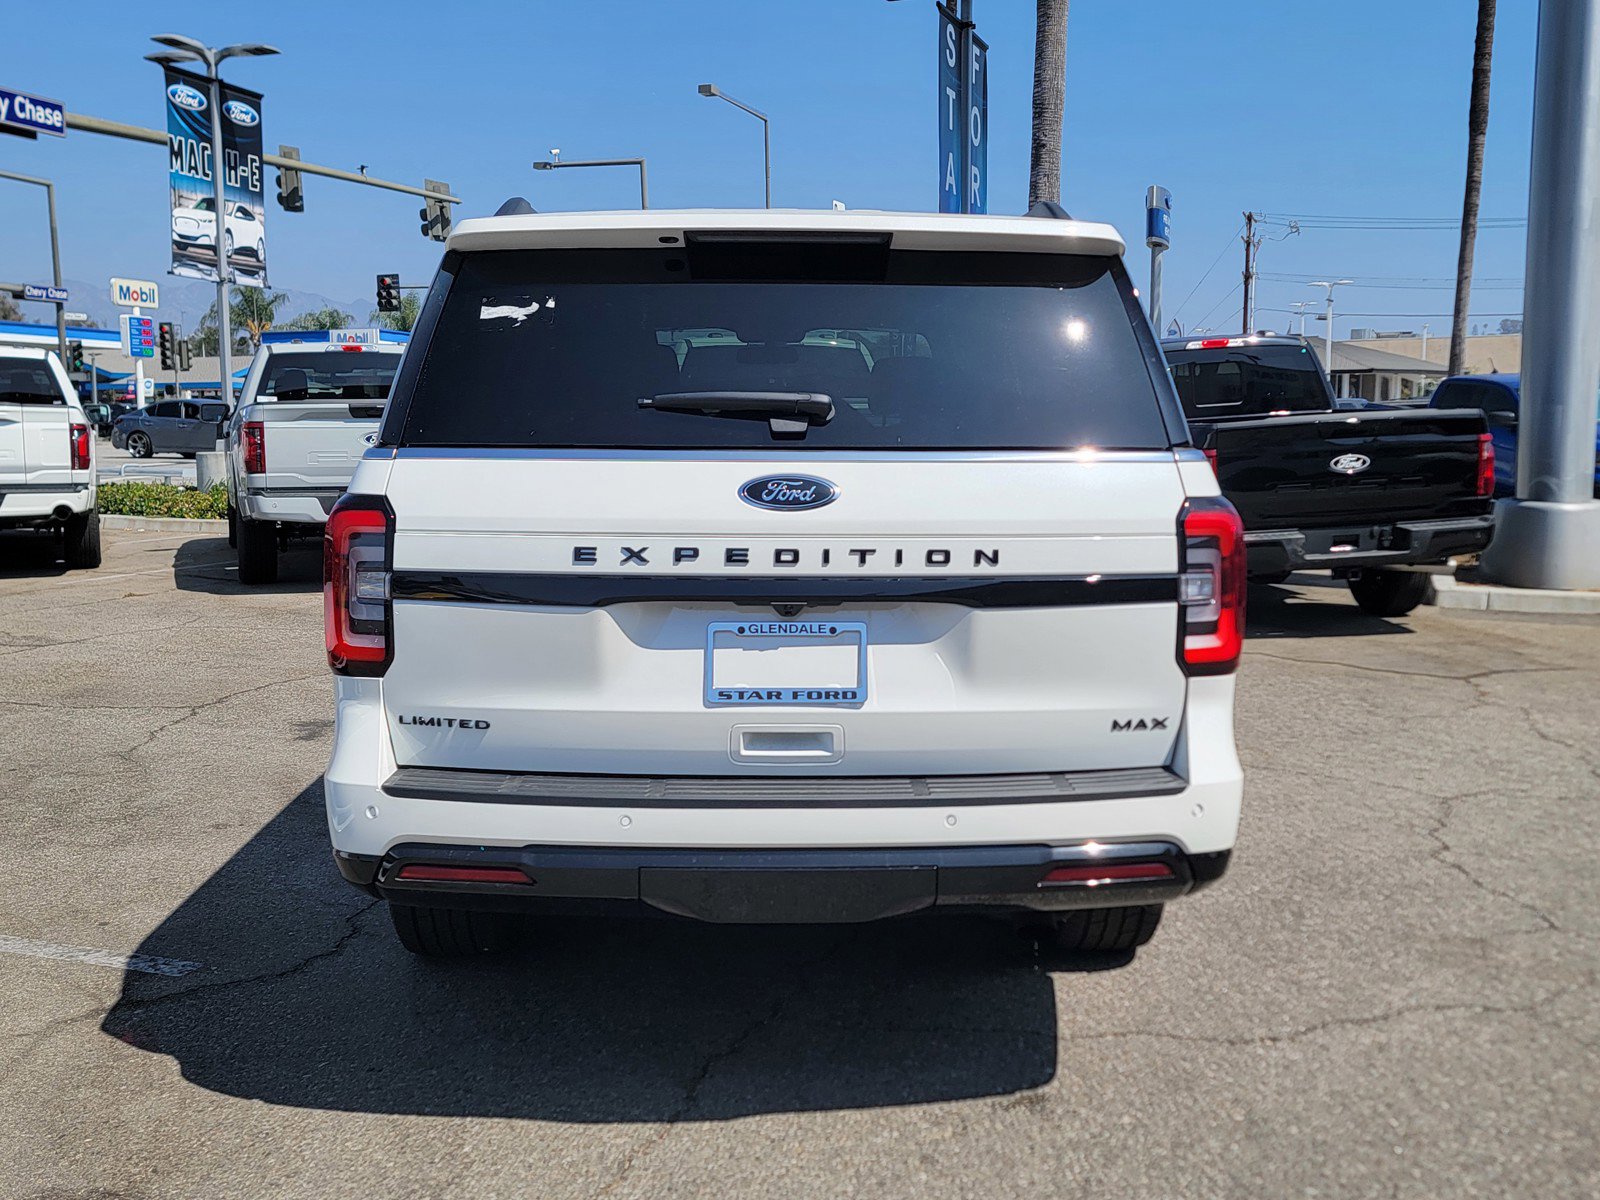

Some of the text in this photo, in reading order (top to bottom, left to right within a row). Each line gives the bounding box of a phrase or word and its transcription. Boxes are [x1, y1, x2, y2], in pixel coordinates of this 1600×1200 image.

[14, 95, 63, 128] Chase
[25, 285, 68, 299] Chevy Chase
[118, 285, 155, 304] Mobil
[336, 332, 369, 343] Mobil
[761, 480, 816, 503] Ford
[572, 546, 1000, 567] EXPEDITION
[748, 623, 828, 635] GLENDALE
[718, 690, 858, 701] STAR FORD
[398, 715, 491, 730] LIMITED
[1110, 716, 1170, 733] MAX
